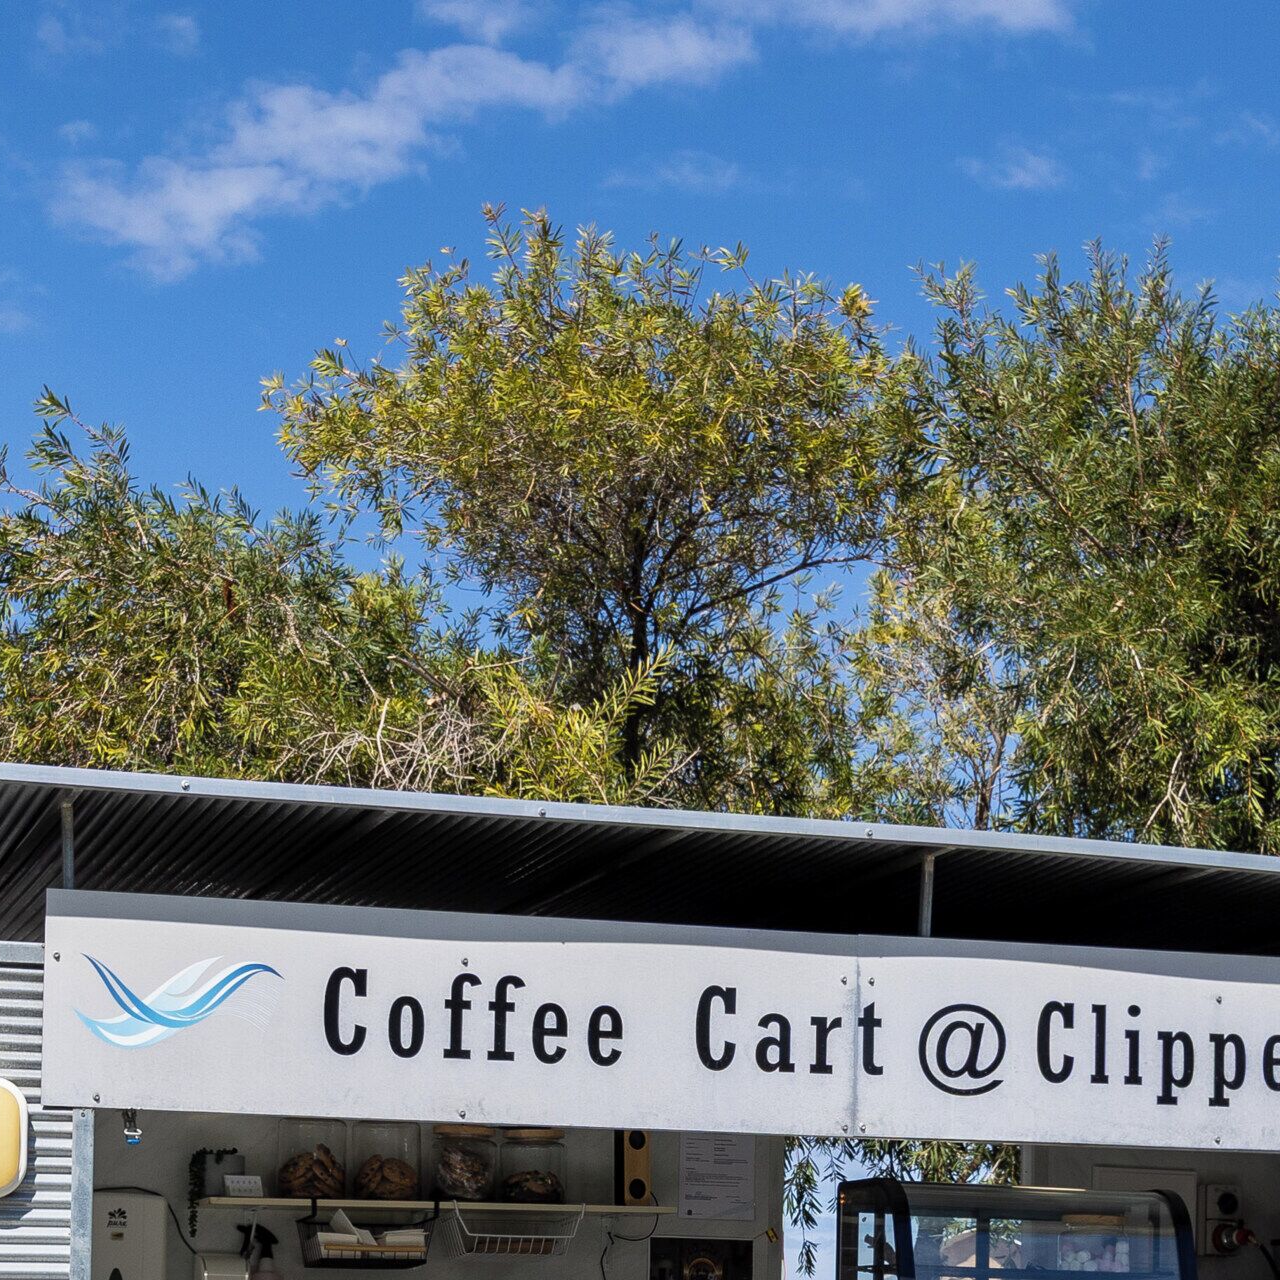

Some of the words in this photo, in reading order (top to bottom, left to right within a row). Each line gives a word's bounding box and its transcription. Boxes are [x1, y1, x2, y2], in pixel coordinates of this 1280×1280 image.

[323, 966, 623, 1067] Coffee
[695, 985, 884, 1076] Cart
[918, 1003, 1006, 1097] @
